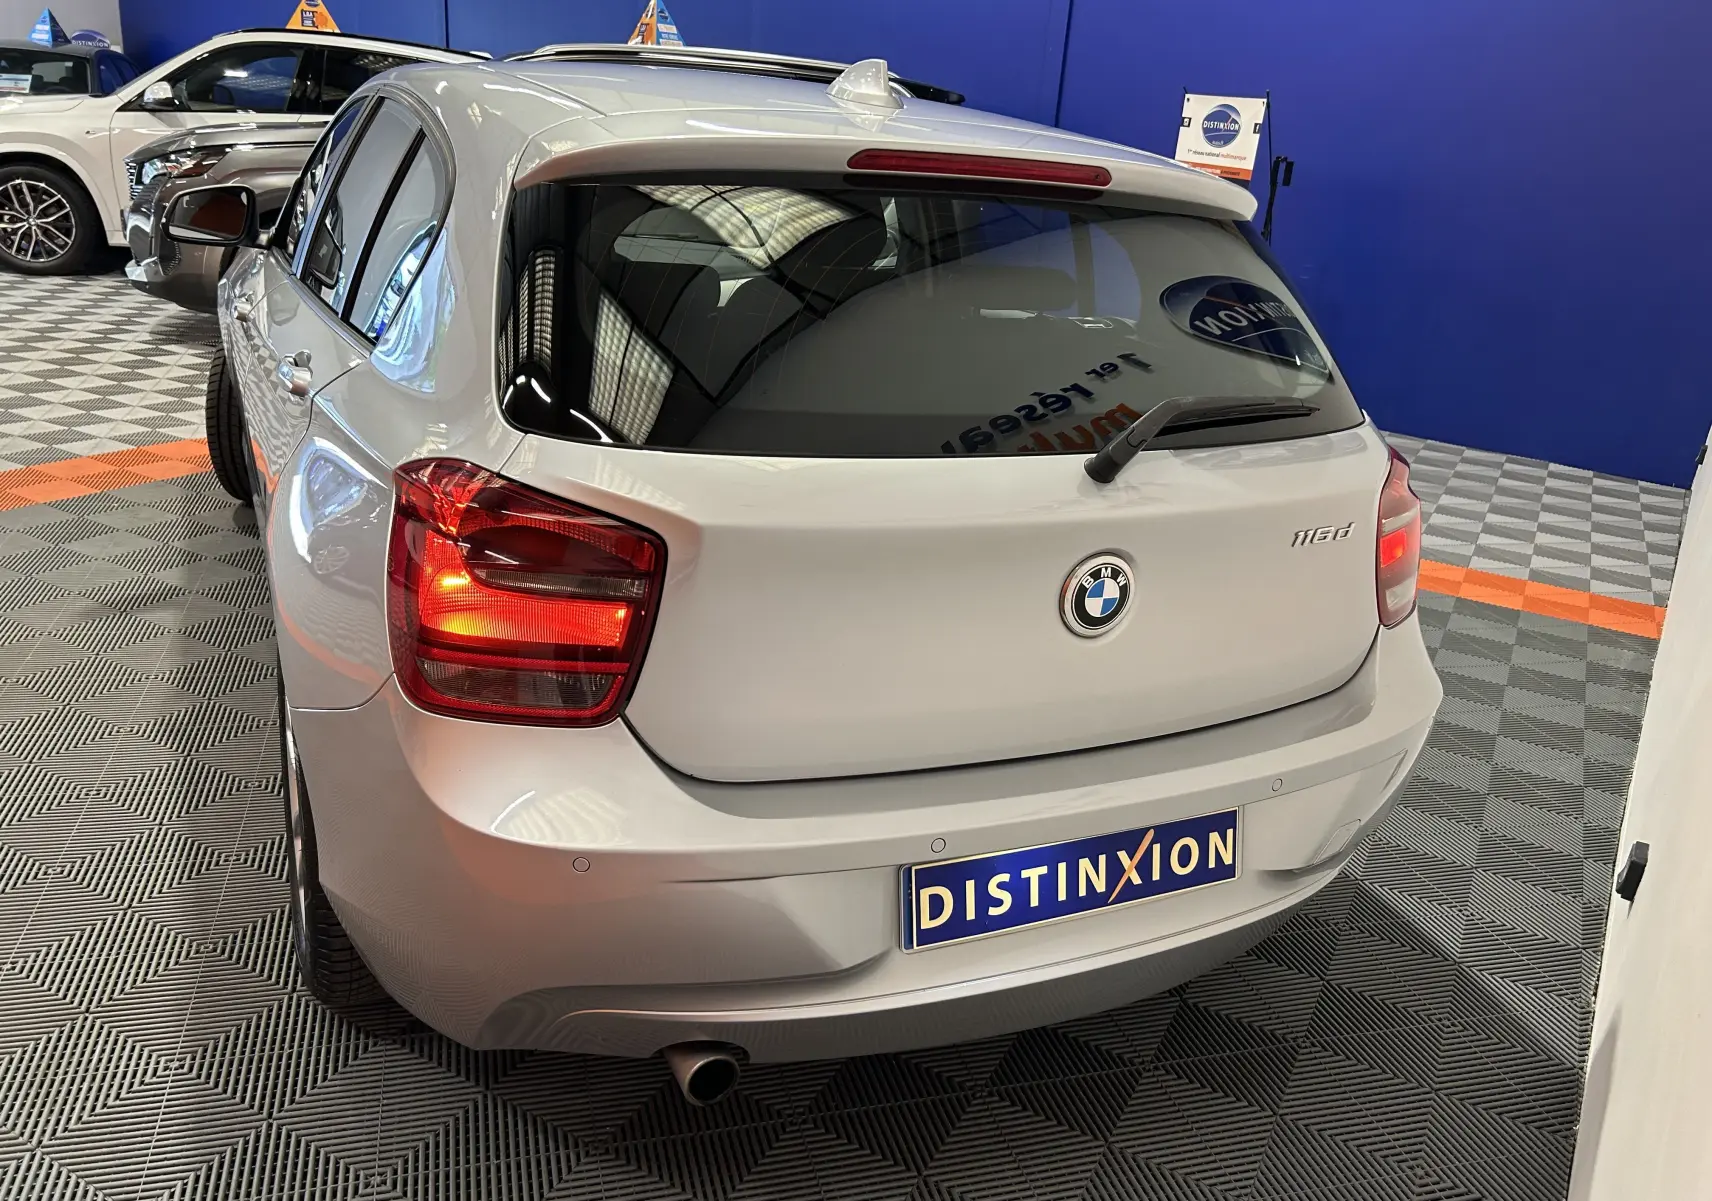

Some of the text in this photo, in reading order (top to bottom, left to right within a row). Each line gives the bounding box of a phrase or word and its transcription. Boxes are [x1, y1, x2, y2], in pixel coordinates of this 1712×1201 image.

[72, 40, 109, 48] DISTINXION
[1203, 119, 1240, 132] DISTINXION
[1291, 521, 1356, 548] 116d
[1081, 567, 1127, 588] BMW
[919, 828, 1234, 930] DISTINXION
